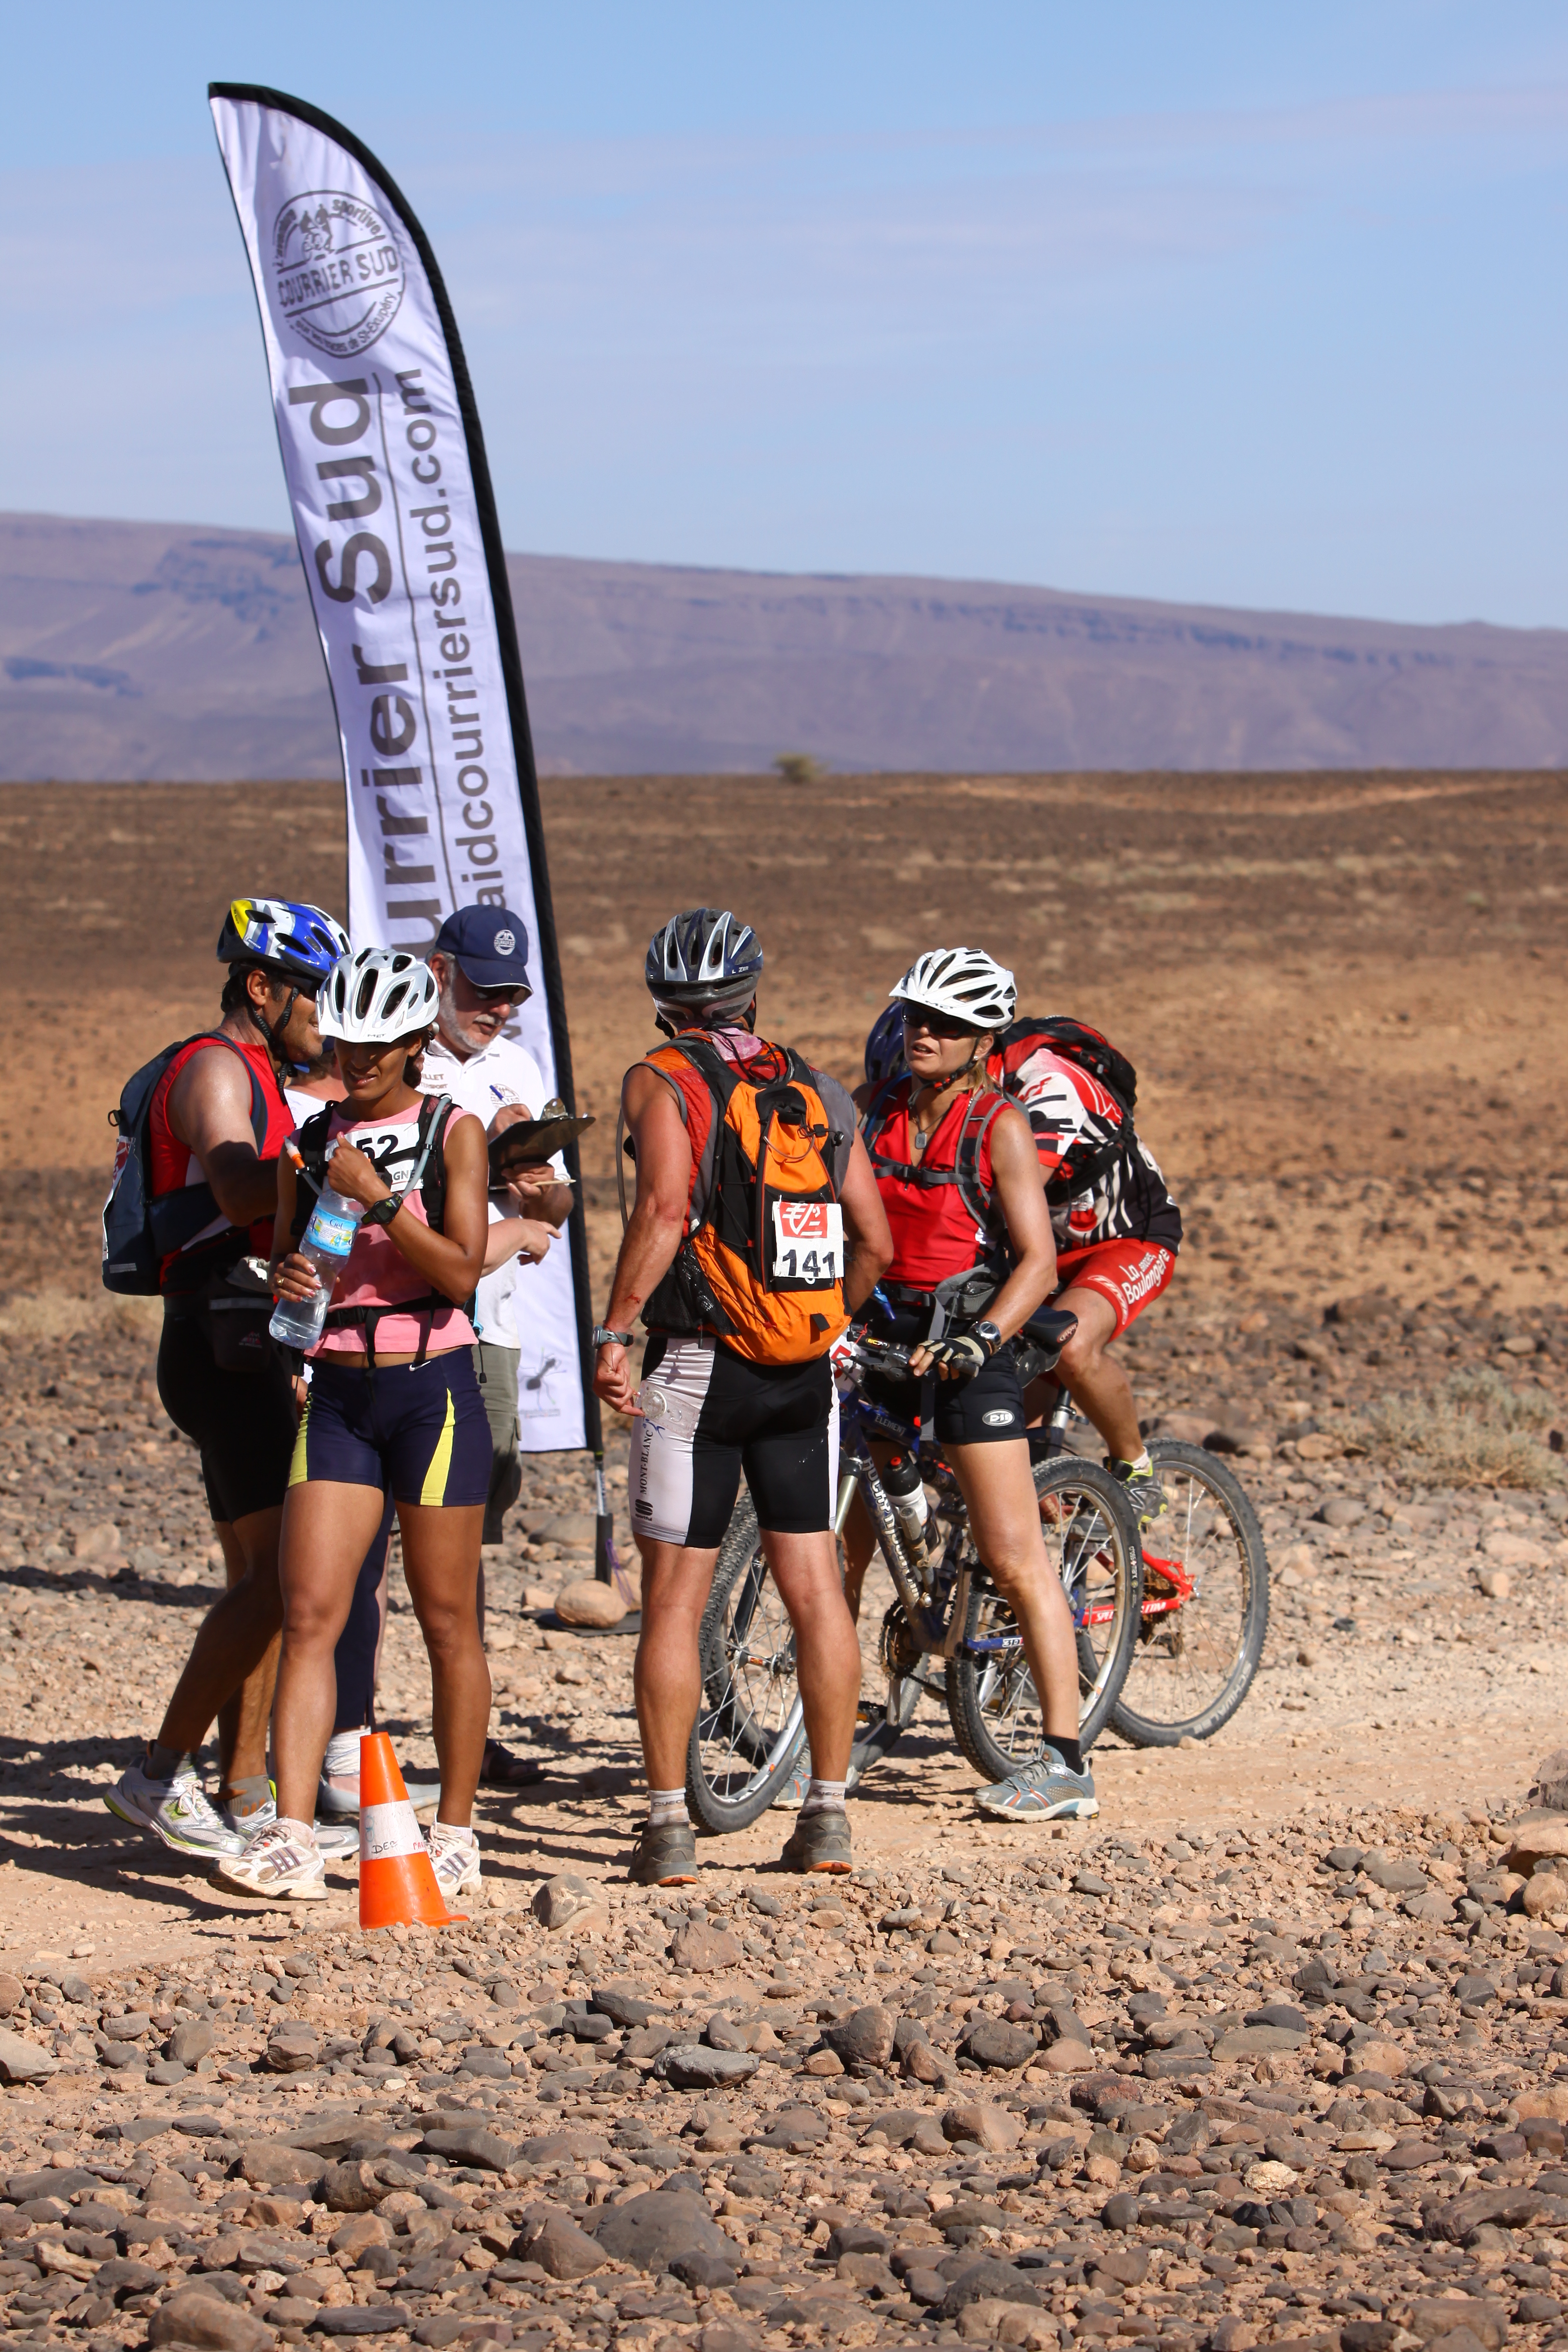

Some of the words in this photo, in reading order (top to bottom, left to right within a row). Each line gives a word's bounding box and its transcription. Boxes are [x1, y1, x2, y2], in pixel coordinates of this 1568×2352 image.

[277, 259, 354, 308] COURRIER
[356, 245, 398, 281] SUD
[288, 378, 392, 605] Sud
[394, 368, 506, 908] aidcourriersud.com
[351, 643, 443, 960] urrier
[393, 1169, 416, 1181] GNE
[329, 1218, 343, 1229] Ciel
[782, 1249, 835, 1278] 141
[1119, 1265, 1140, 1282] La
[875, 1414, 907, 1436] ELEMENT
[640, 1430, 653, 1495] MONT-BLANC
[862, 1455, 891, 1514] ROCKY
